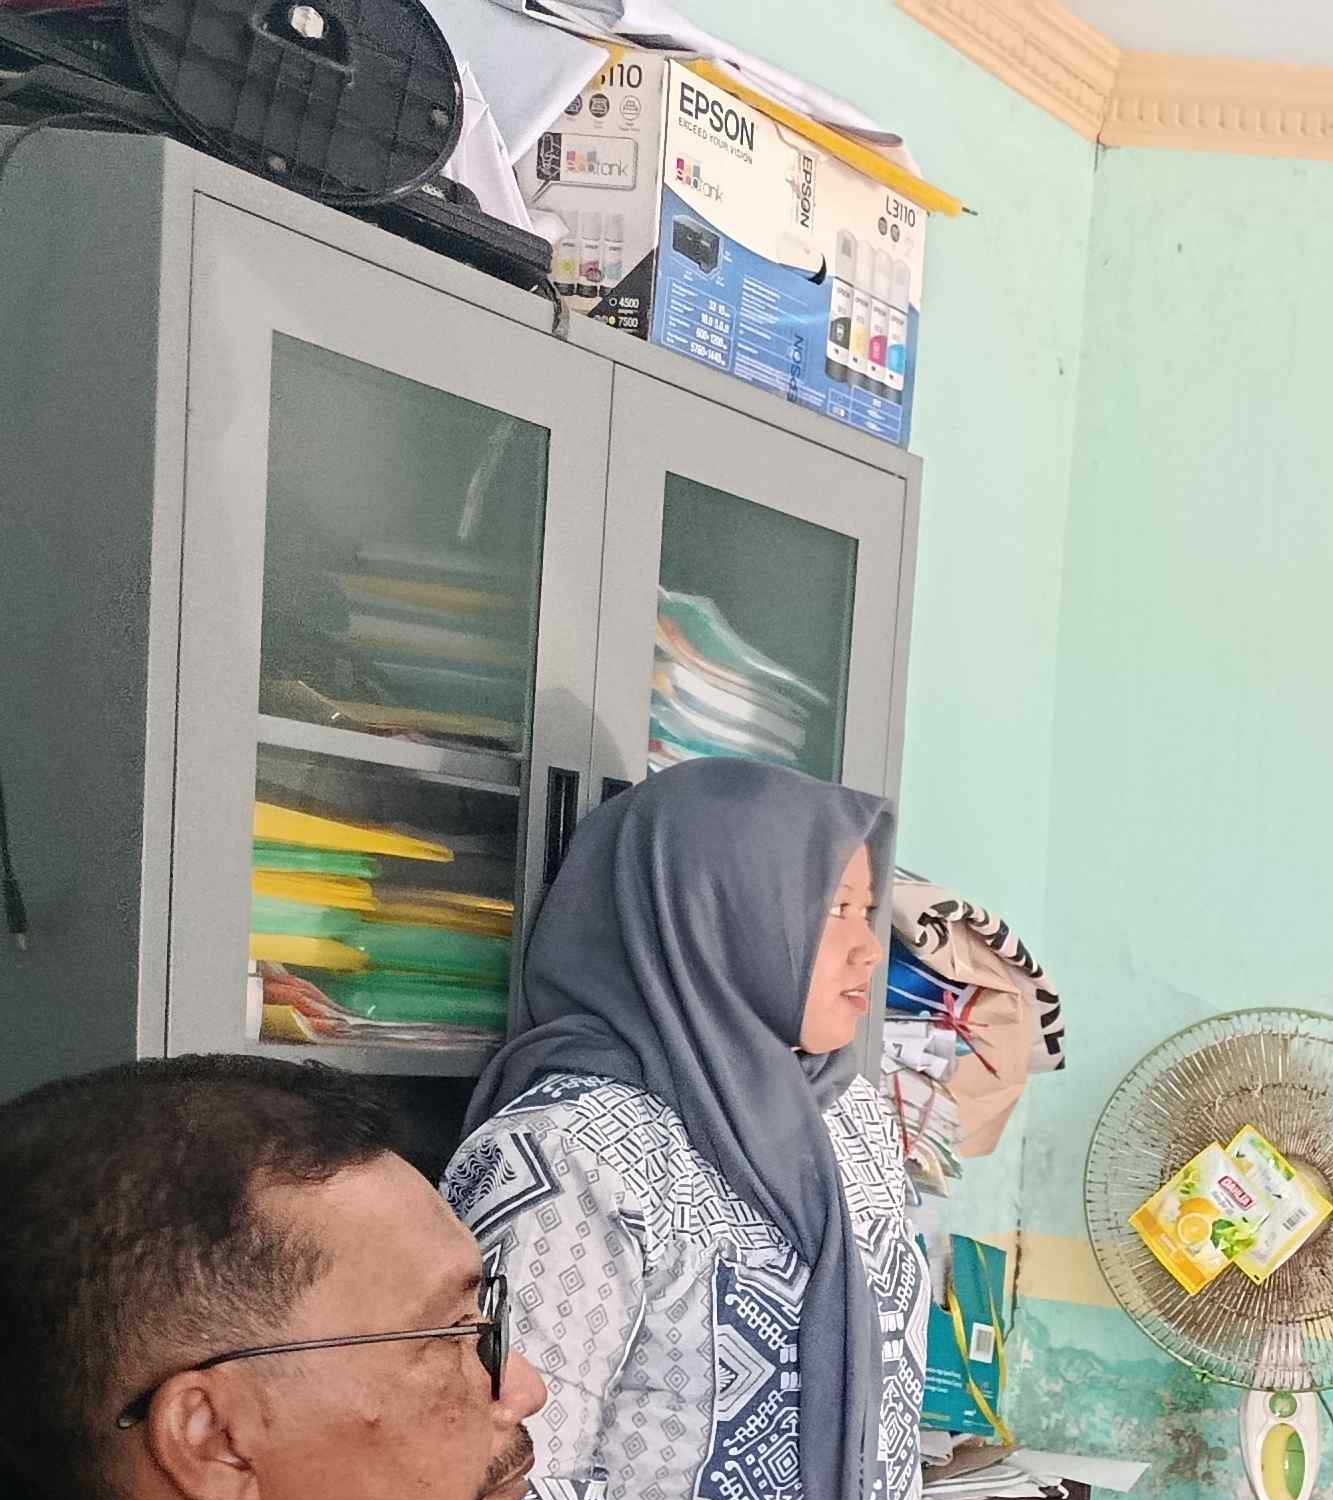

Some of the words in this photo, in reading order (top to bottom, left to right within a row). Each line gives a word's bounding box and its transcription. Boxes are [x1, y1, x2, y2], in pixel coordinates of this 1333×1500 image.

[601, 63, 642, 88] 110
[679, 82, 755, 150] EPSON
[678, 117, 707, 140] EXCEED
[708, 133, 729, 152] YOUR
[730, 143, 754, 165] VISION
[800, 155, 814, 228] EPSON
[886, 195, 916, 228] L3110
